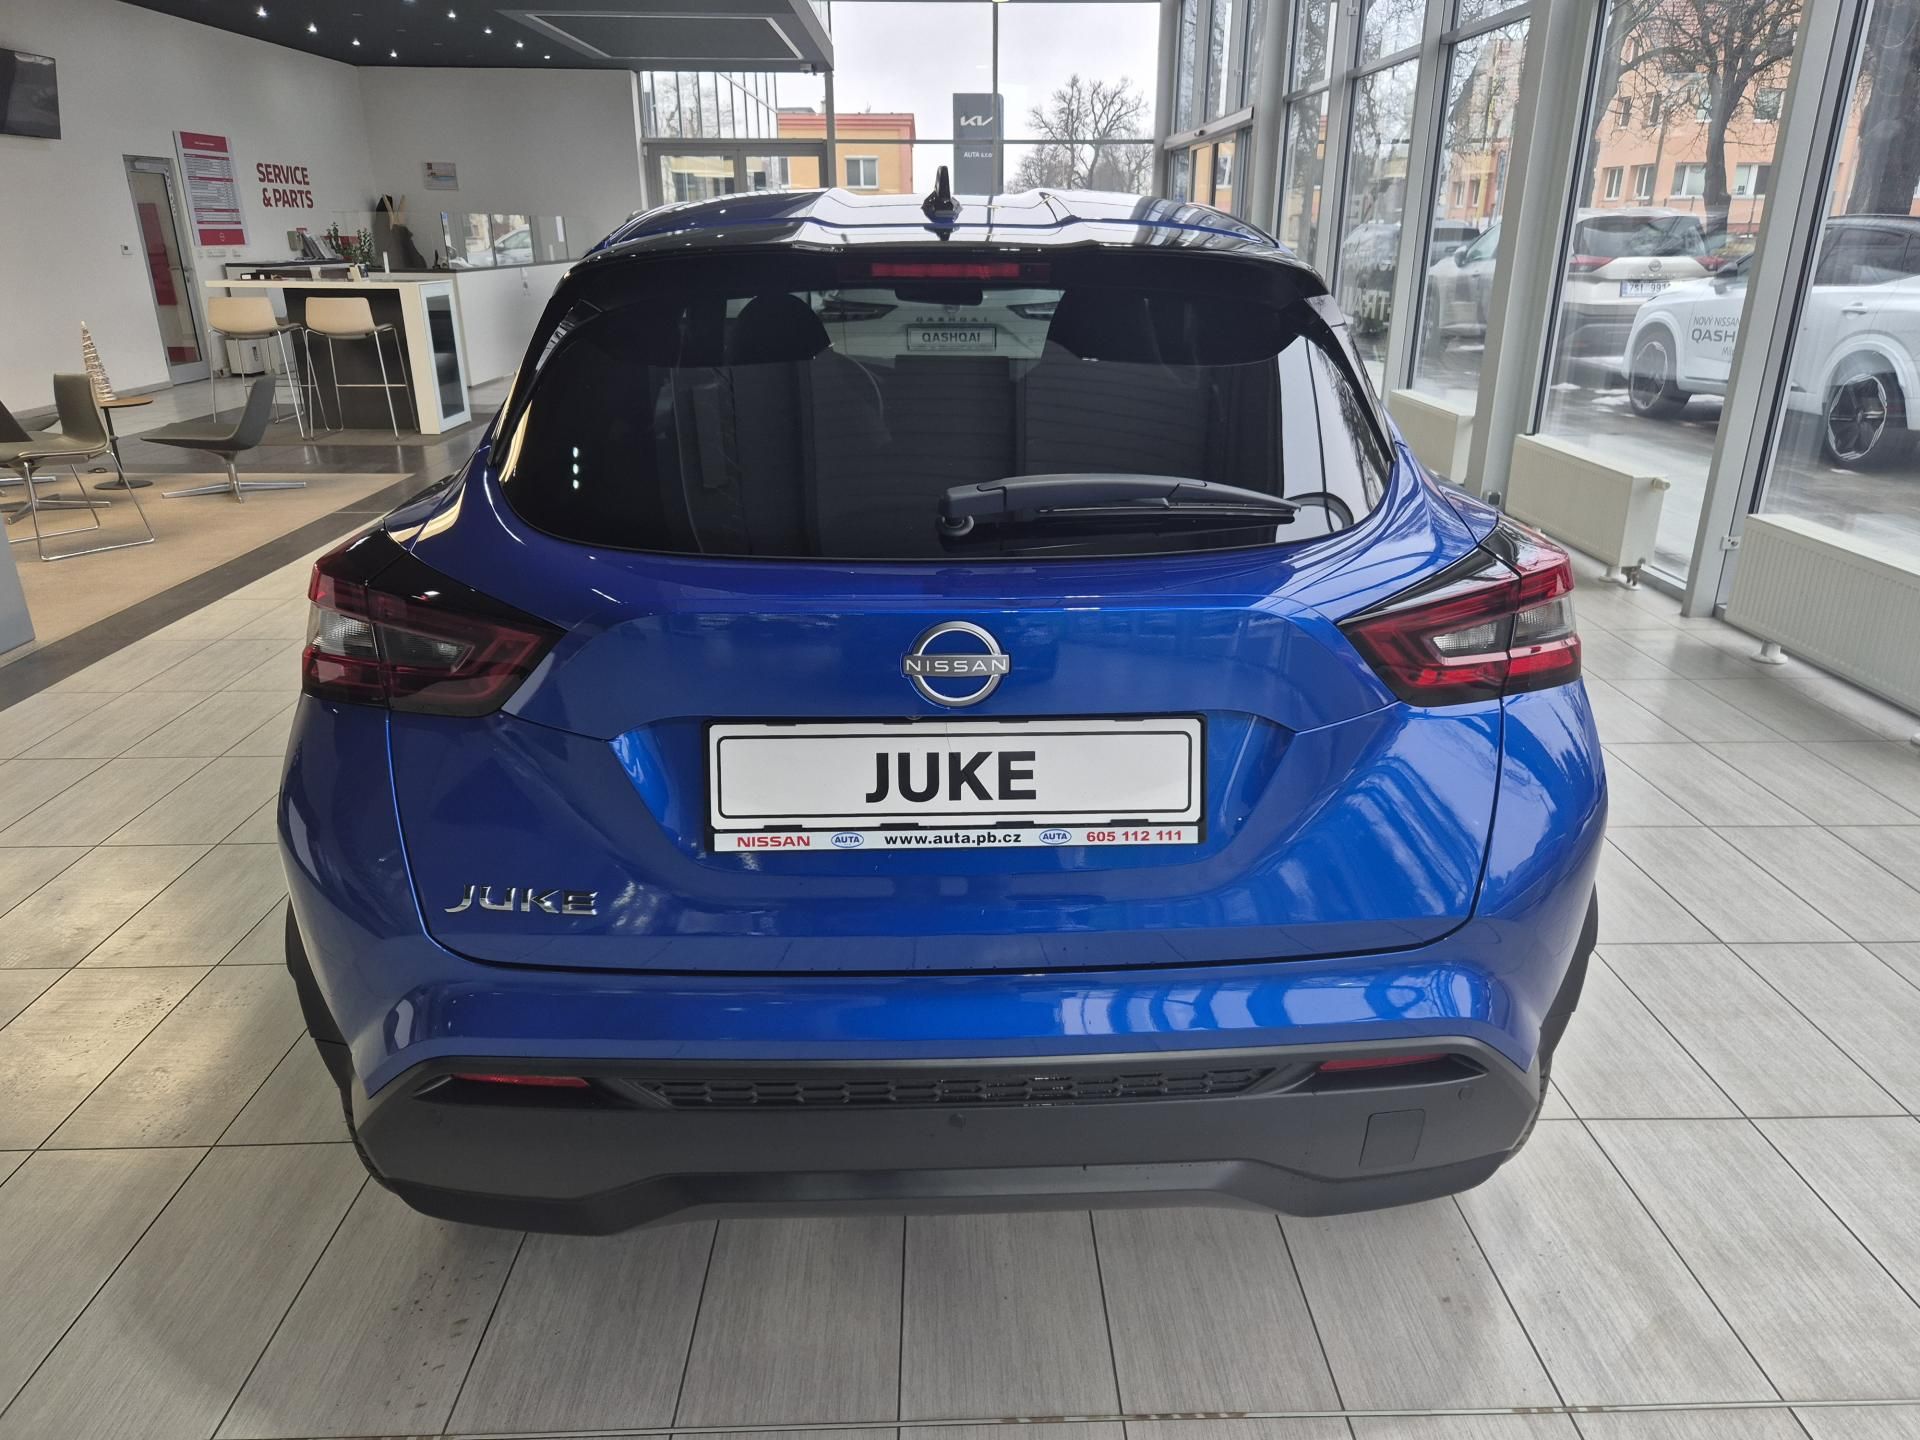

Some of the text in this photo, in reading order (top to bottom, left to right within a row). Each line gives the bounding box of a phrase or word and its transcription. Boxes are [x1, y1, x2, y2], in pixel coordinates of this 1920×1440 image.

[256, 162, 310, 186] SERVICE
[262, 187, 273, 208] &
[272, 188, 314, 209] PARTS
[921, 332, 981, 343] QASHQAI
[905, 658, 1007, 673] NISSAN
[866, 751, 1037, 803] JUKE
[737, 830, 1182, 848] NISSAN AUTA www.auta.pb.cz AUTA 605 112 111
[444, 884, 599, 916] JUKE
